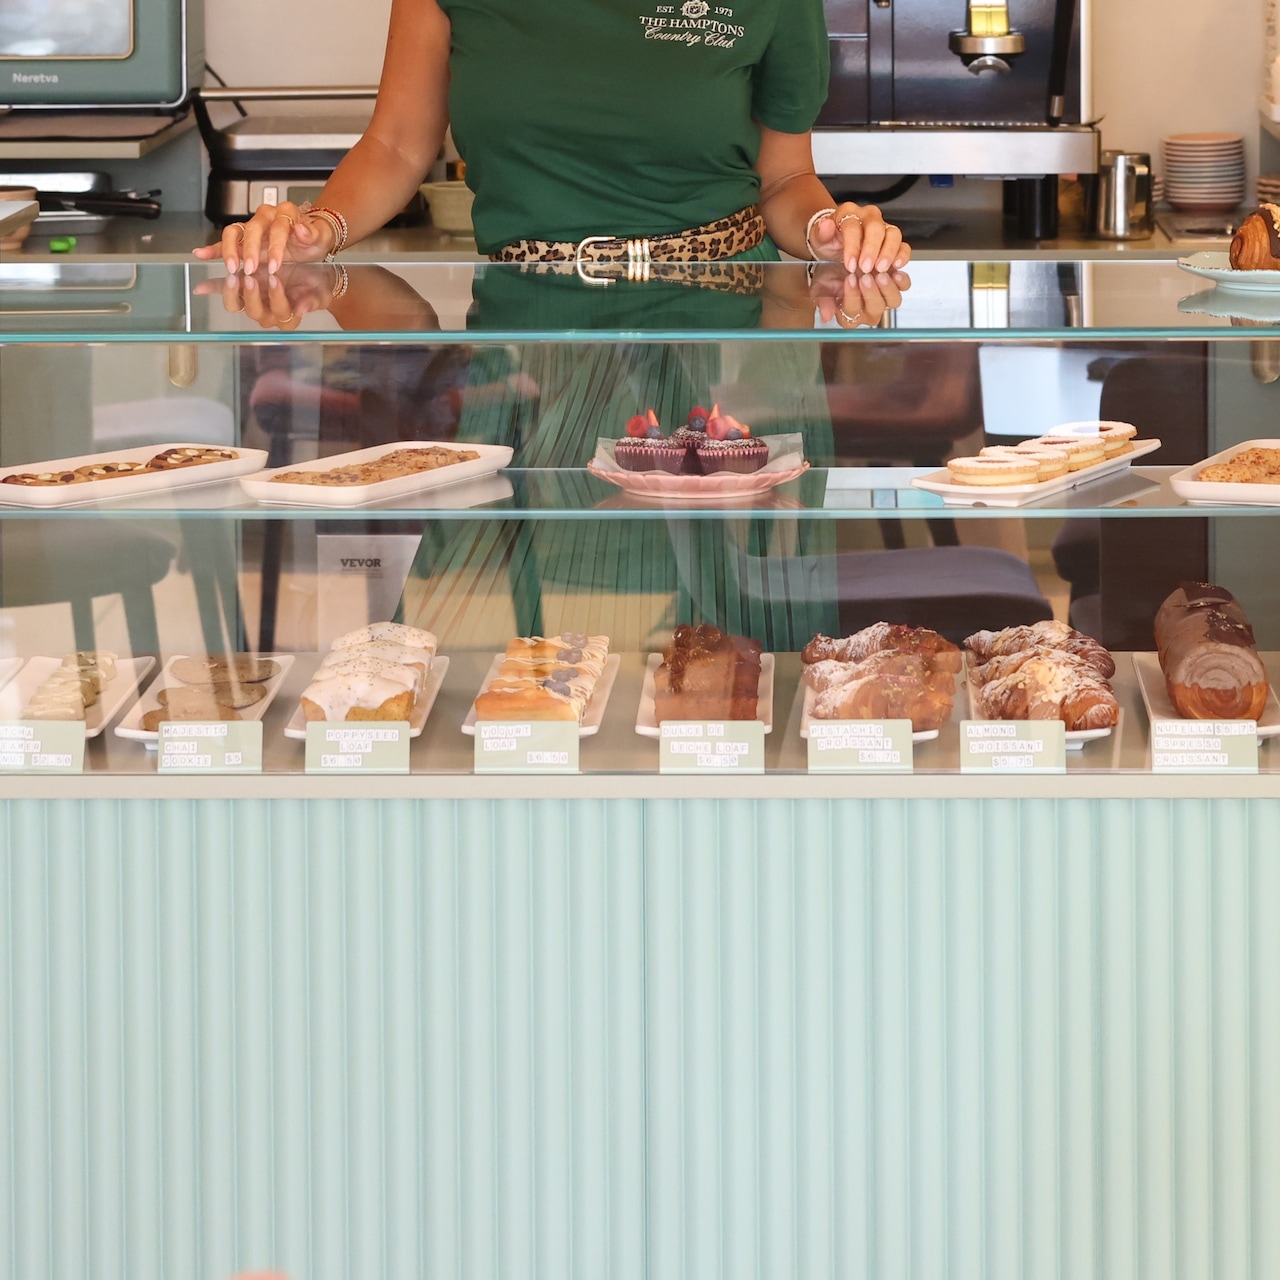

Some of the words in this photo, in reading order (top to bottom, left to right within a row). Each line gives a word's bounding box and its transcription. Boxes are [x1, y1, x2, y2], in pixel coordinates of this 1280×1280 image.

[656, 5, 675, 14] EST.
[714, 6, 734, 18] 1973
[639, 15, 668, 28] THE
[670, 18, 745, 37] HAMPTONS
[644, 26, 702, 47] Country
[704, 30, 737, 49] Club
[12, 72, 59, 84] Neretva
[340, 558, 382, 568] VEVOR
[163, 726, 227, 735] MAJESTIC
[482, 726, 530, 736] YOGURT
[662, 726, 702, 735] DULCE
[708, 725, 723, 734] DE
[811, 726, 883, 735] PISTACHIO
[967, 726, 1016, 736] ALMOND
[1157, 724, 1212, 734] NUTELLA
[1215, 724, 1255, 734] $5.75
[327, 731, 398, 740] POPPYSEED
[165, 743, 196, 752] CHAI
[340, 742, 371, 751] LOAF
[485, 740, 516, 750] LOAF
[671, 743, 710, 753] LECHE
[717, 744, 748, 753] LOAF
[818, 740, 891, 749] CROISSANT
[970, 741, 1041, 752] CROISSANT
[1155, 739, 1221, 748] ESPRESSO
[33, 755, 71, 765] $2.50
[162, 756, 210, 766] COOKIE
[322, 756, 361, 766] $6.50
[528, 753, 568, 762] $6.50
[860, 753, 899, 762] $6.75
[993, 757, 1033, 767] $5.75
[1155, 754, 1228, 764] CROISSANT
